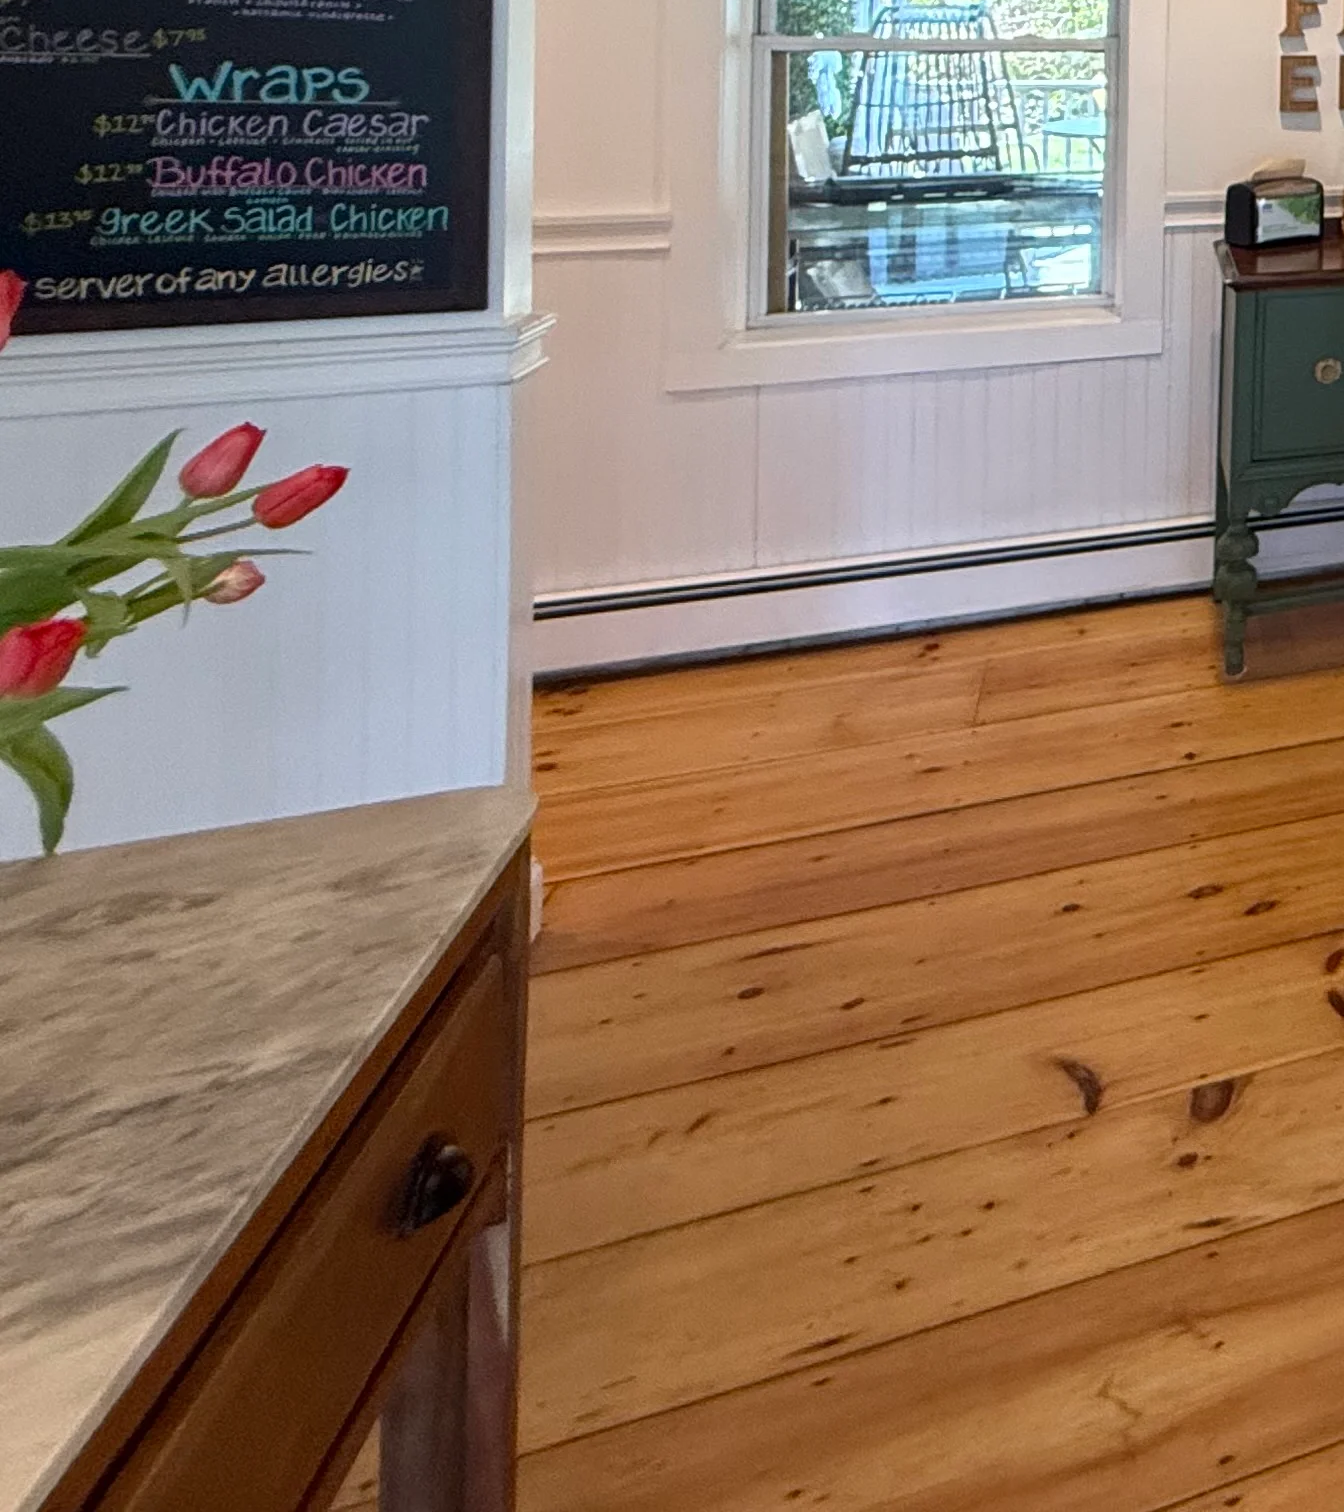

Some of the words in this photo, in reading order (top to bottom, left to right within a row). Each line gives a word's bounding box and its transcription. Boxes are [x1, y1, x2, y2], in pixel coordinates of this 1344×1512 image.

[154, 110, 289, 138] Chicken
[302, 109, 430, 138] Caesar
[144, 156, 297, 188] Buffalo
[303, 156, 427, 188] Chicken
[219, 201, 314, 234] Salad
[329, 201, 450, 233] Chicken
[33, 271, 155, 302] server
[155, 265, 193, 296] of
[193, 268, 257, 295] any
[261, 258, 411, 289] allergies
